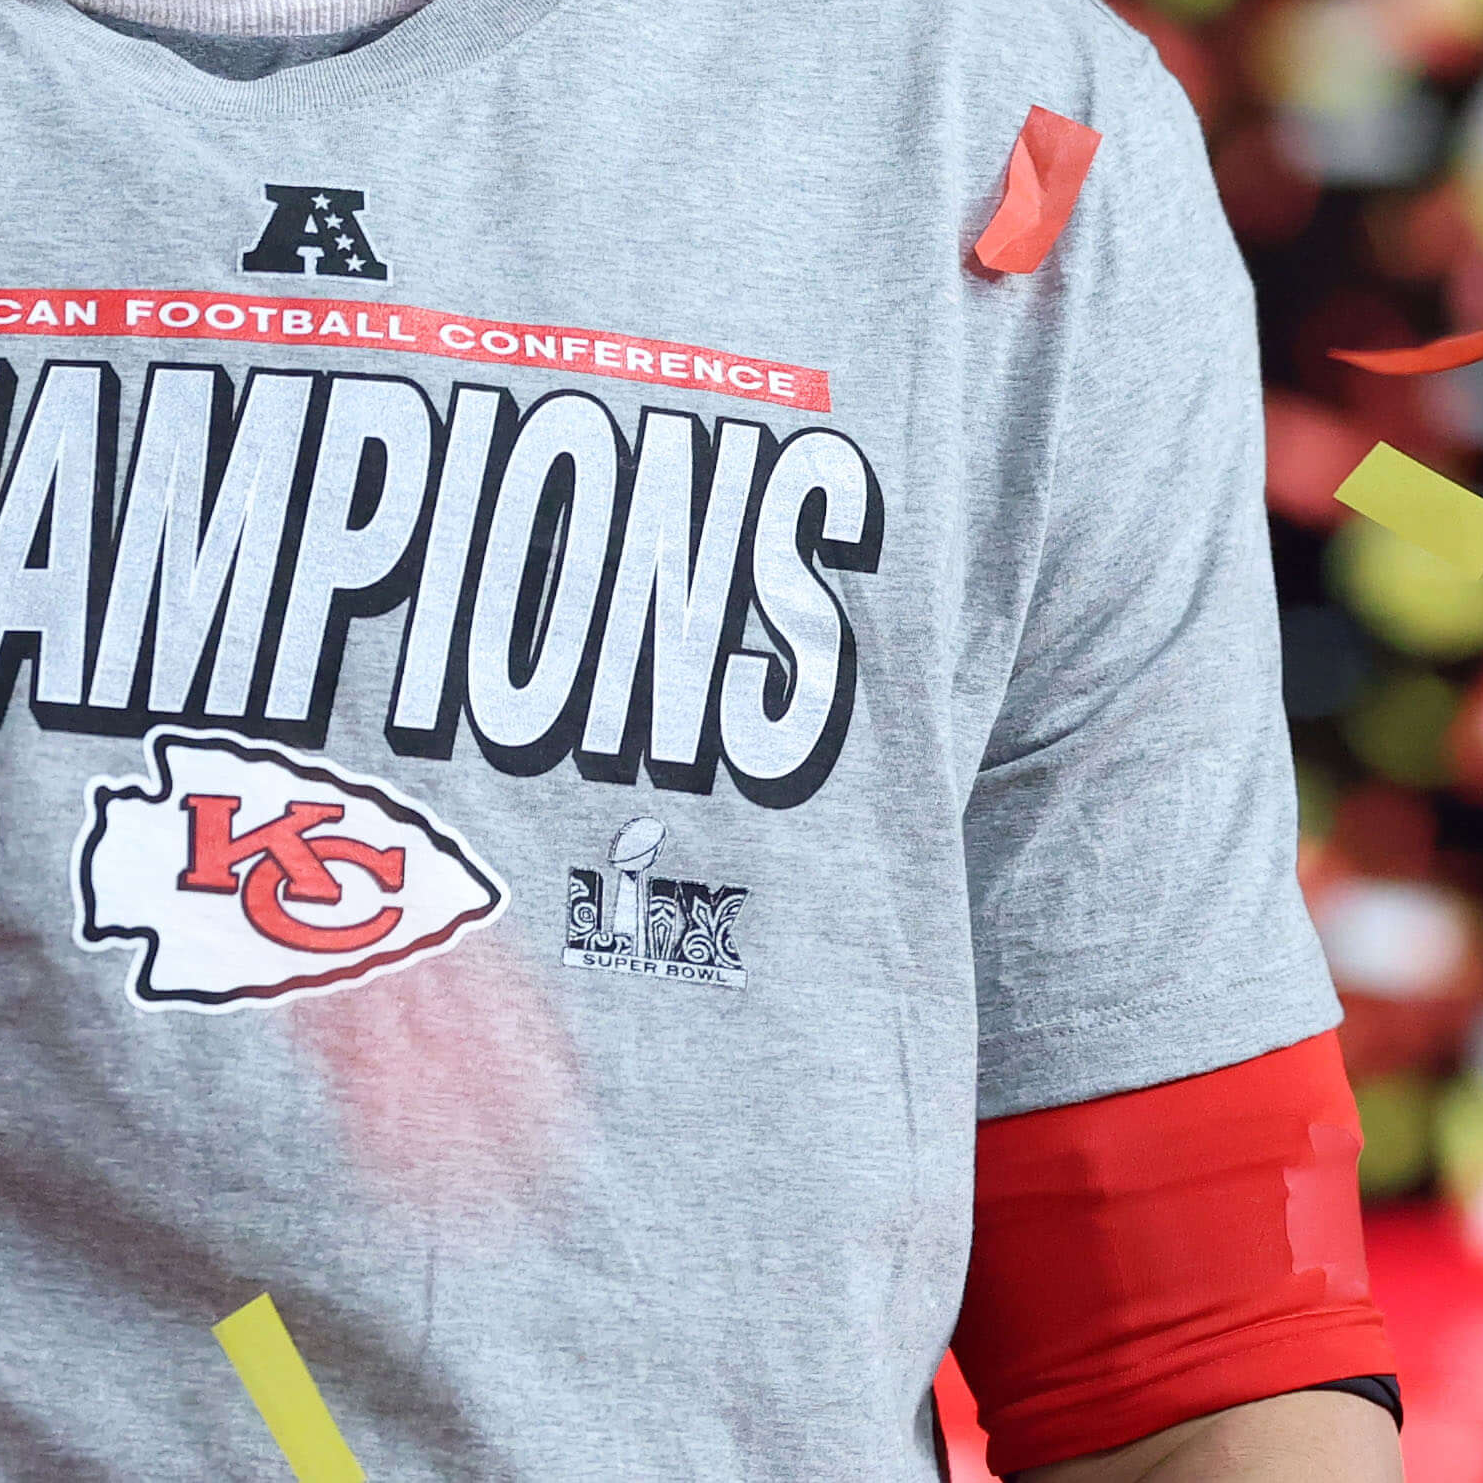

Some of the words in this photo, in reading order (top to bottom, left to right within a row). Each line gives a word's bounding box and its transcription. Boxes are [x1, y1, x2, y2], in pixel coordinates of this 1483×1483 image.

[126, 300, 416, 343] FOOTBALL
[439, 323, 797, 398] CONFERENCE
[177, 793, 406, 954] KC
[582, 953, 657, 974] SUPER
[666, 965, 728, 983] BOWL
